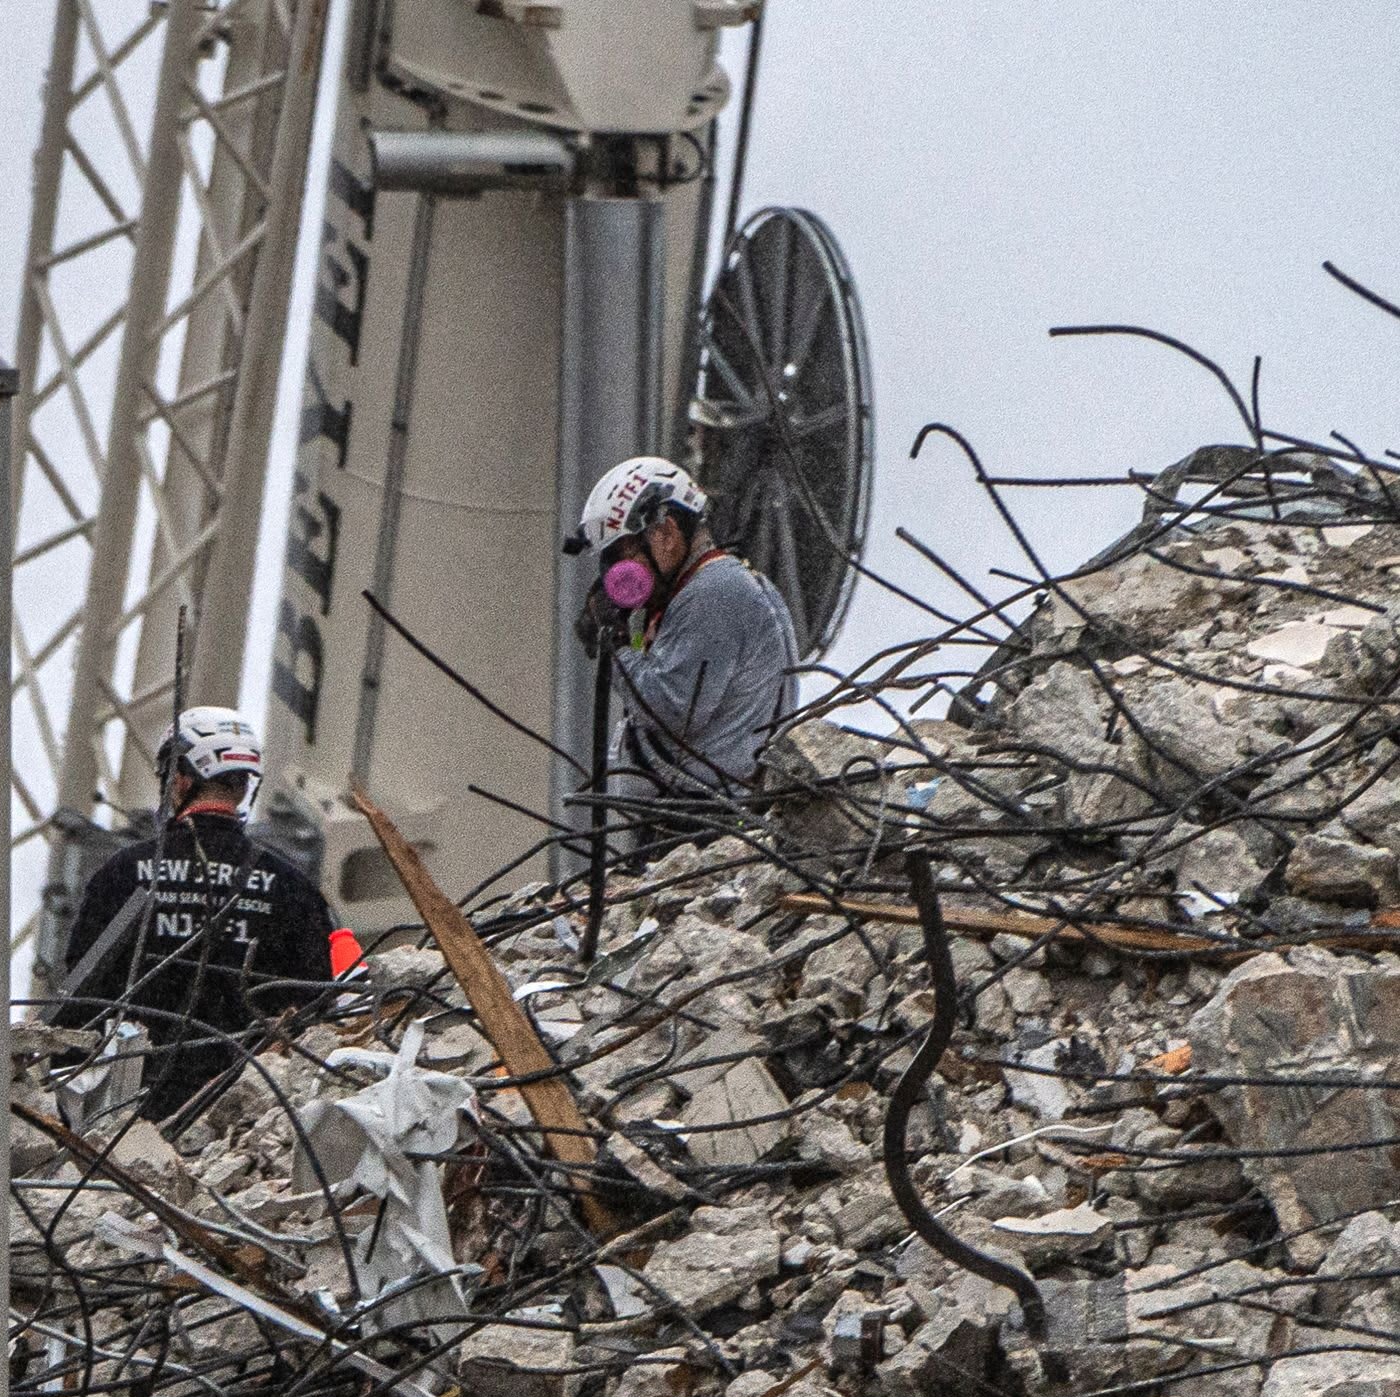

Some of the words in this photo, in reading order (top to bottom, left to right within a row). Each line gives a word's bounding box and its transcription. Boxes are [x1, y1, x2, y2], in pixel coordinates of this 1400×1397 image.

[606, 473, 649, 531] NJ-TF1
[136, 858, 191, 882] NEW
[194, 861, 276, 892] JEREY
